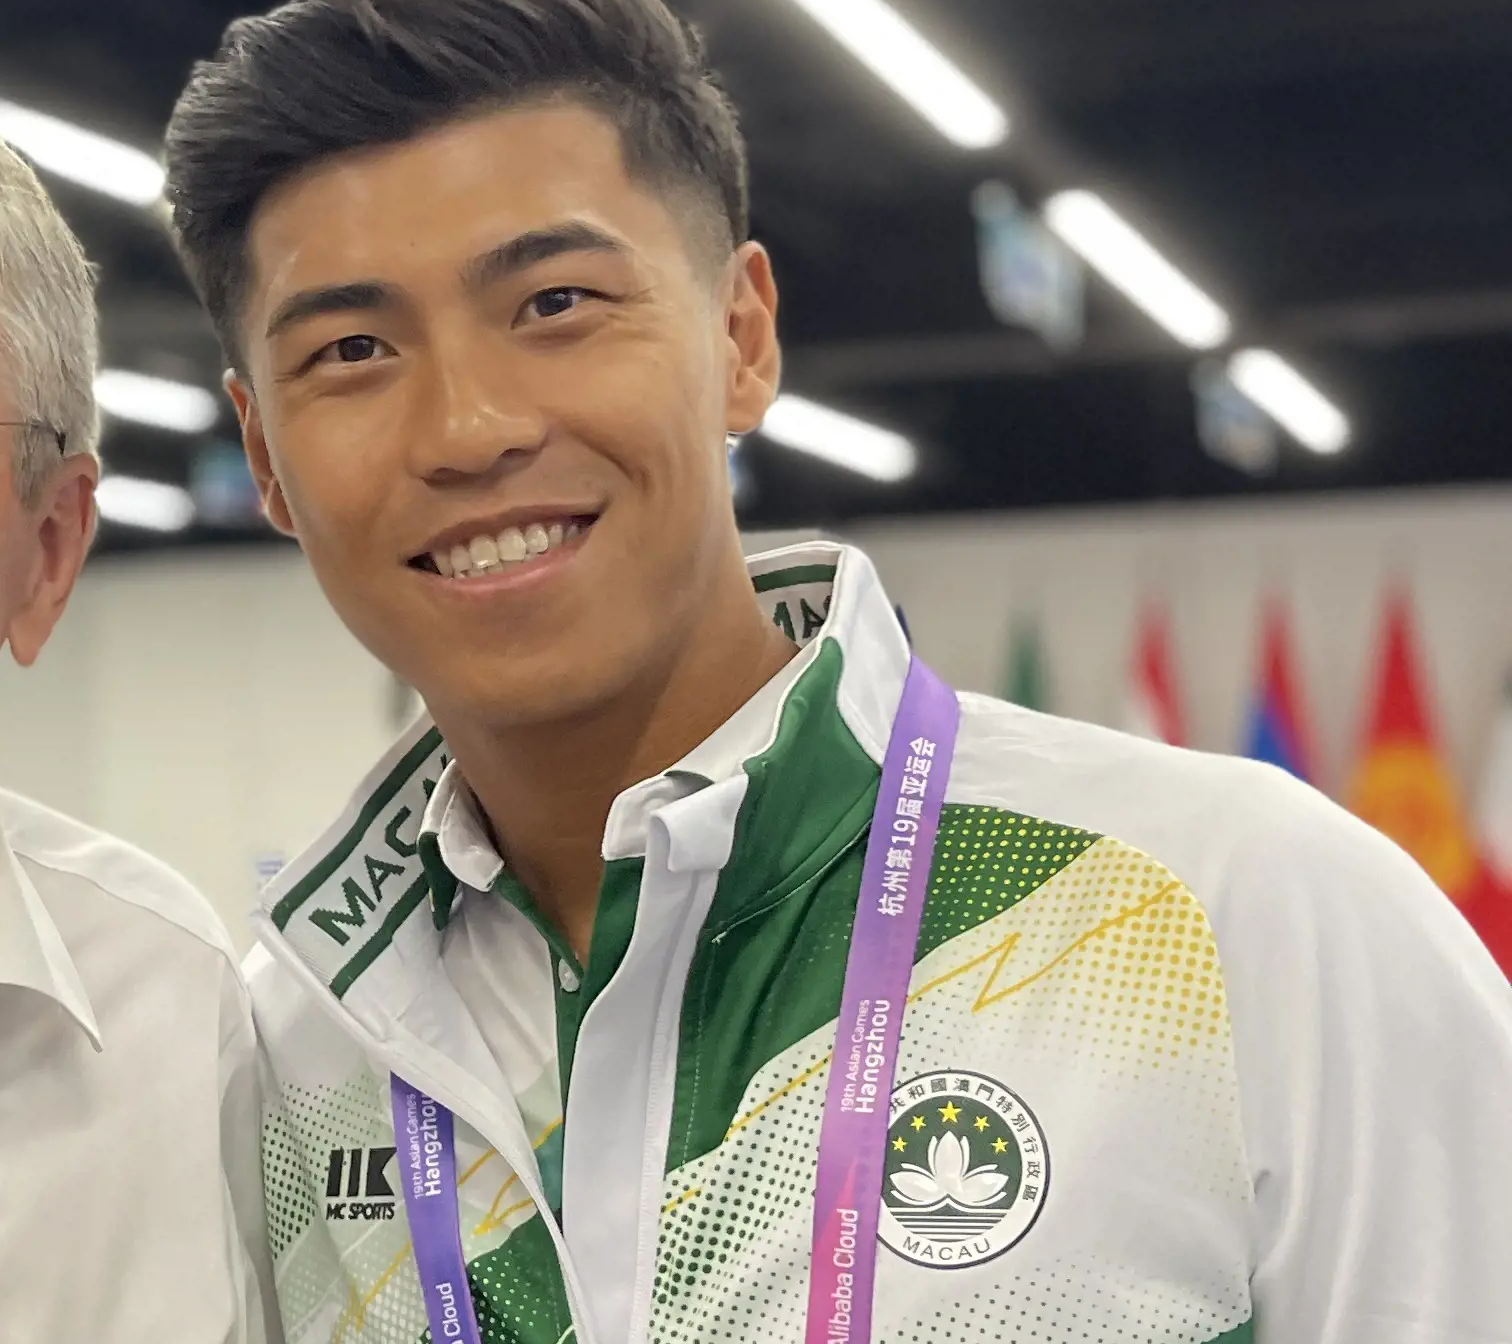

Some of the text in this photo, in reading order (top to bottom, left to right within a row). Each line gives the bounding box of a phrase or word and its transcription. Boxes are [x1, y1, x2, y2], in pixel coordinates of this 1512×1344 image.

[308, 753, 448, 946] MAC
[877, 736, 937, 917] 杭州第19届亚运会
[840, 999, 870, 1113] 19th Asian Games
[855, 999, 891, 1113] Hangzhou
[406, 1093, 424, 1199] 19th Asian Games
[326, 1202, 395, 1220] MC SPORTS
[833, 1208, 859, 1269] Cloud
[903, 1236, 991, 1261] MACAU
[436, 1282, 461, 1337] Cloud
